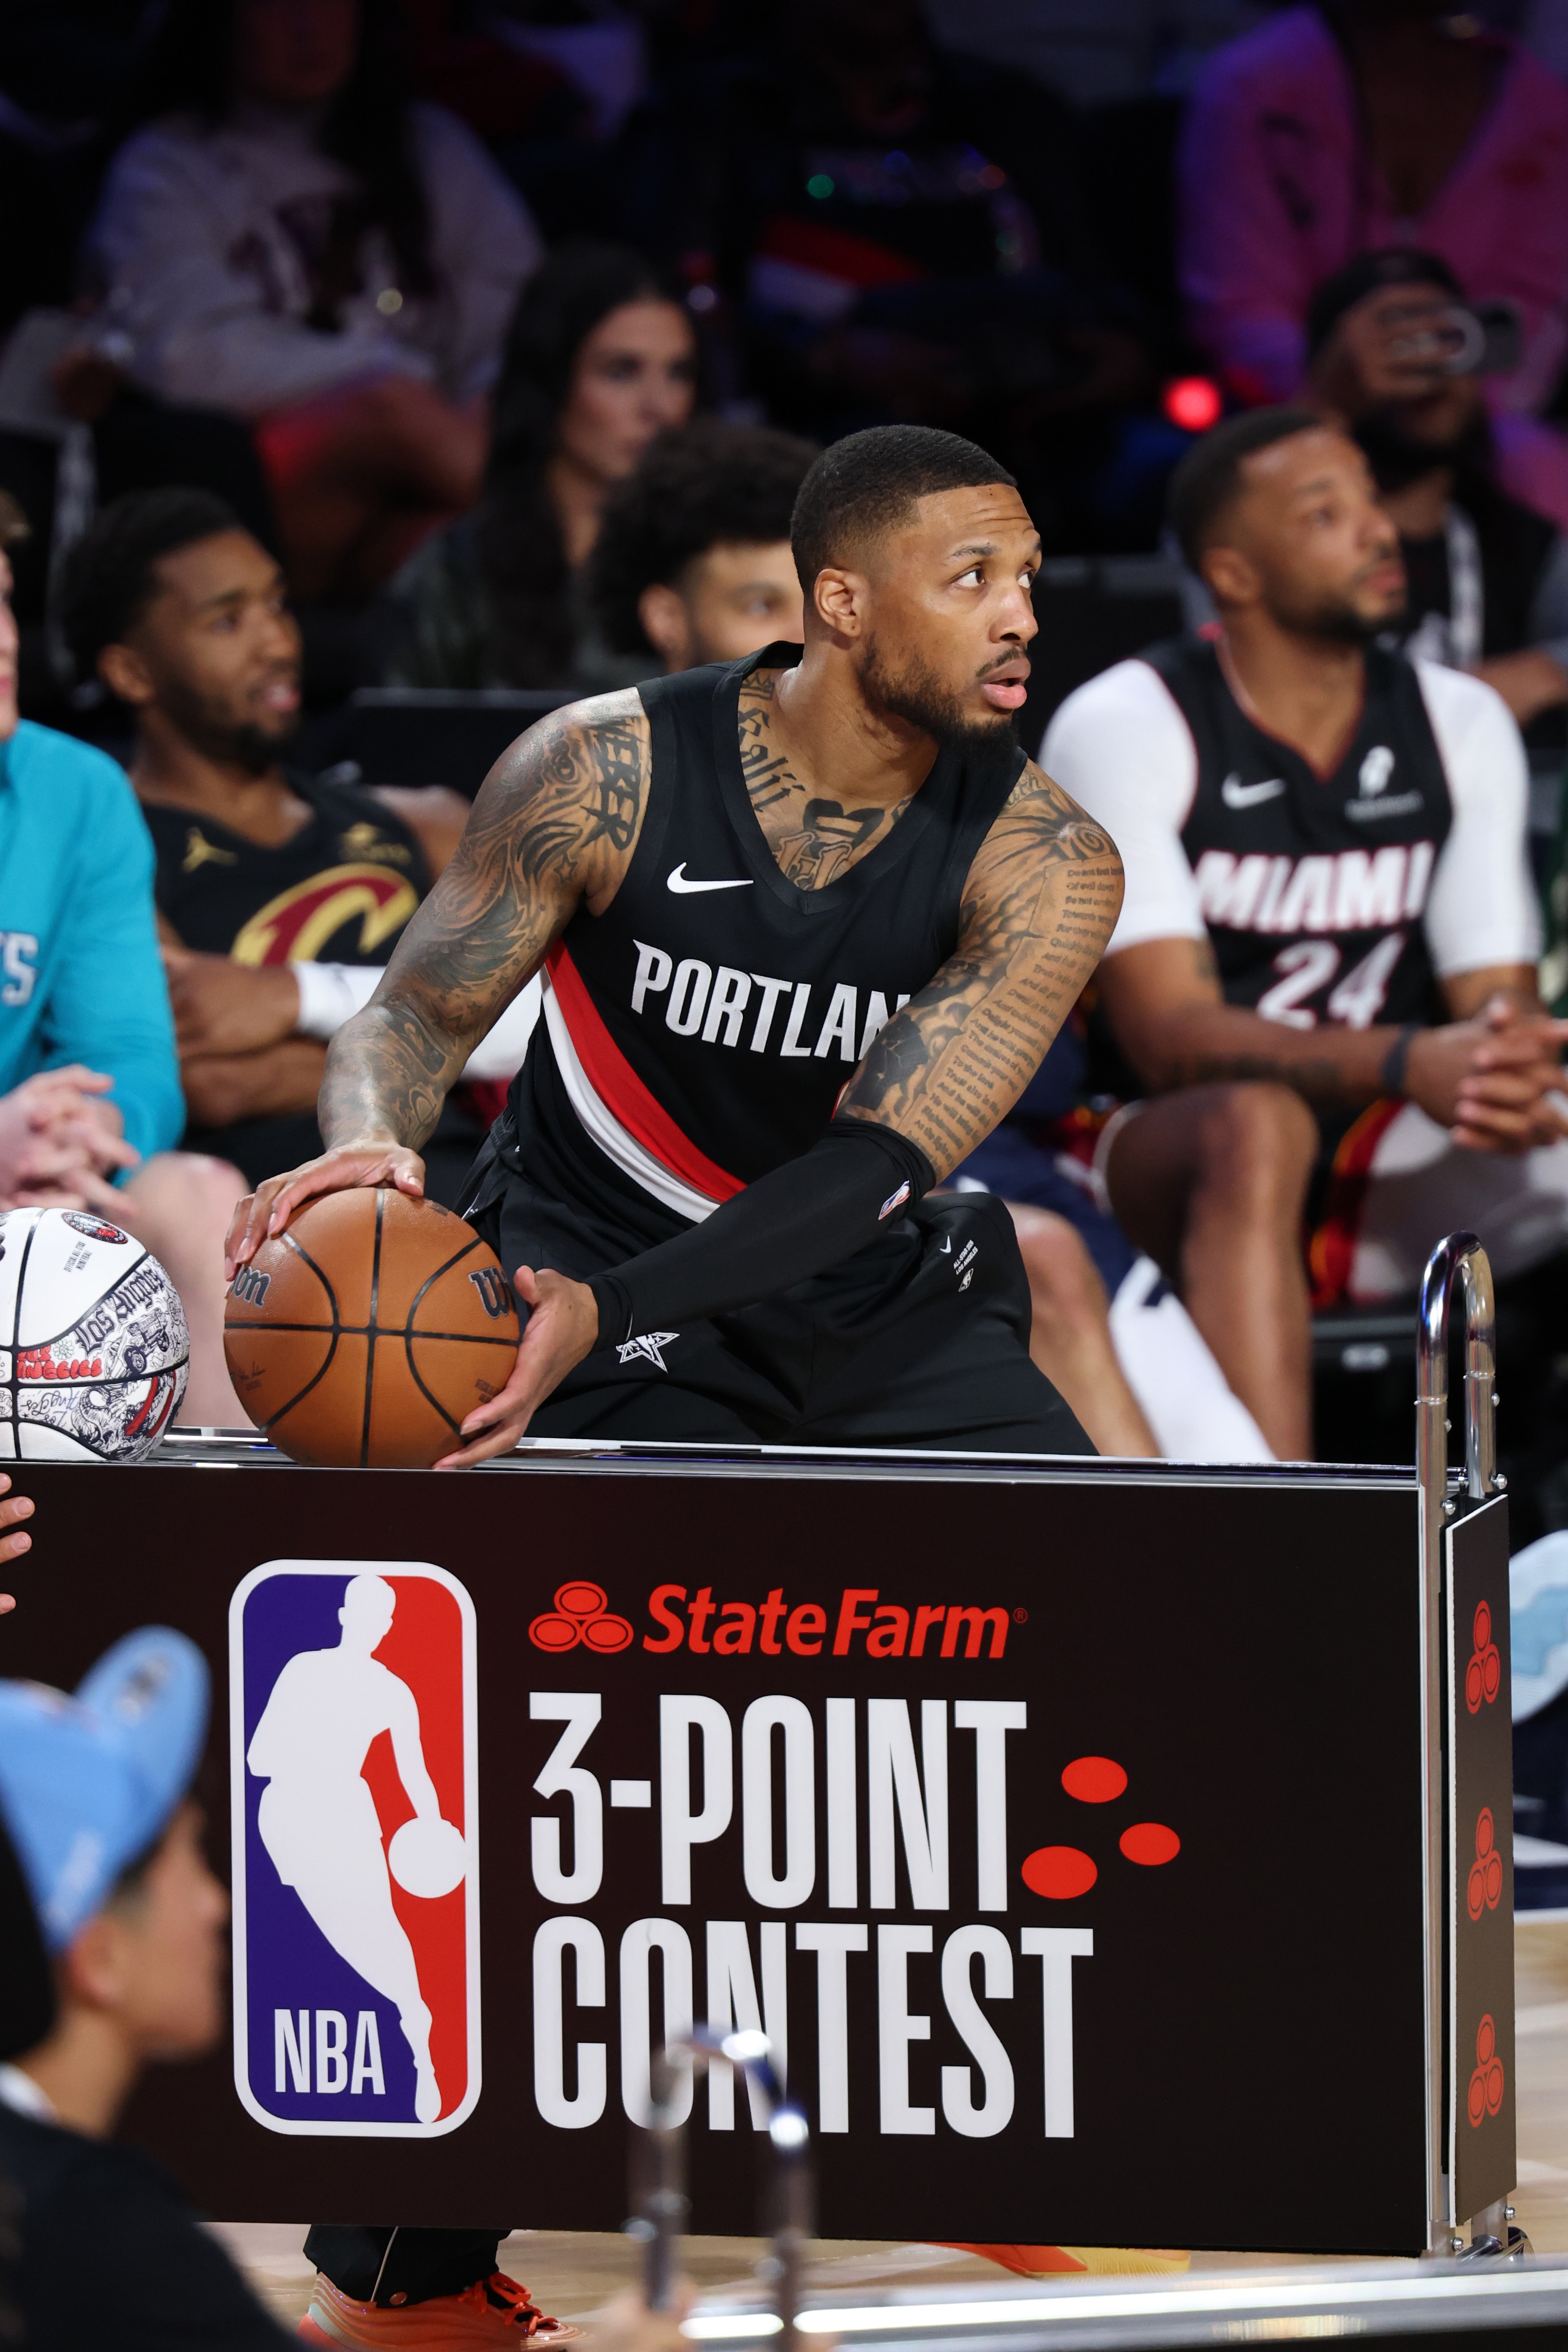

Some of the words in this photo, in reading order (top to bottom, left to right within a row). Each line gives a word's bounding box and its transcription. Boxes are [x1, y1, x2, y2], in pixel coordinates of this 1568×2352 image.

[1195, 840, 1433, 932] MIAMI
[631, 939, 911, 1062] PORTLAN
[1257, 933, 1405, 1030] 24
[529, 1691, 1027, 1912] 3-POINT
[274, 2008, 386, 2095] NBA
[532, 1916, 1094, 2138] CONTEST
